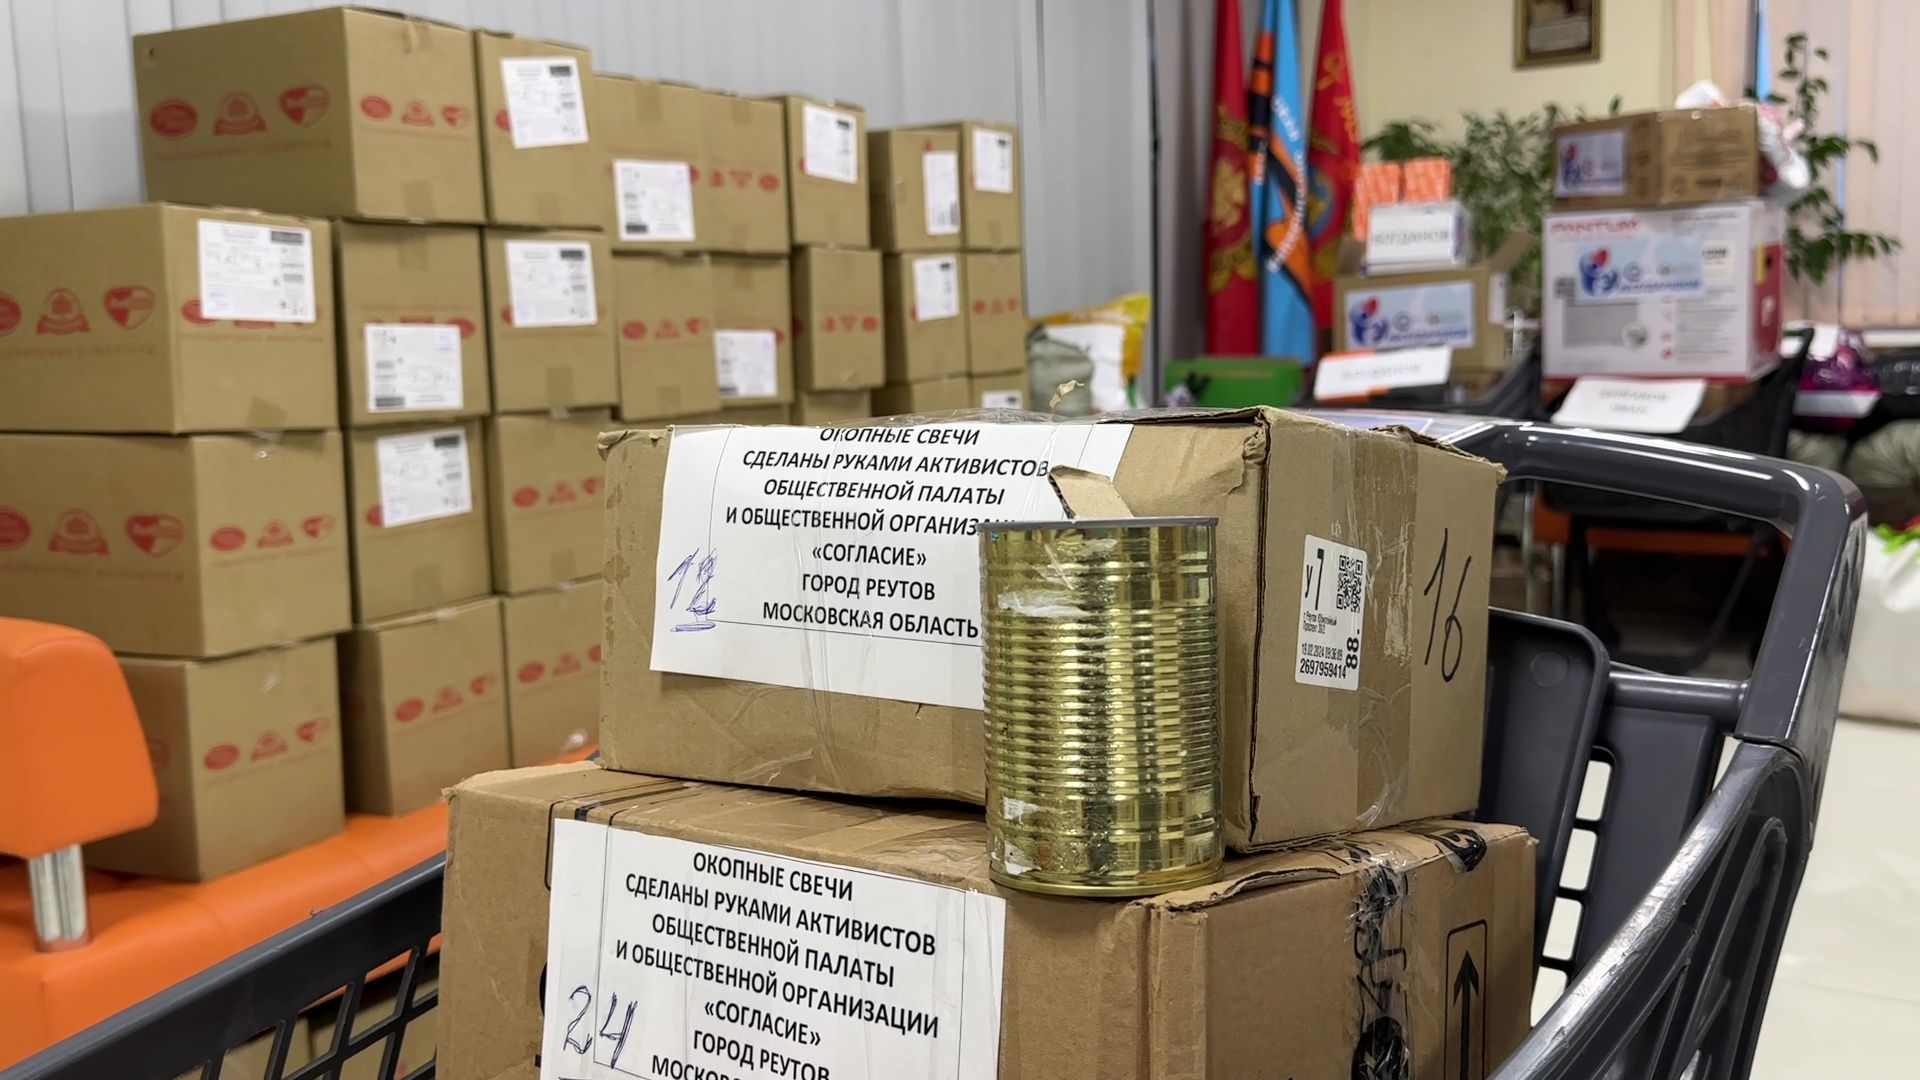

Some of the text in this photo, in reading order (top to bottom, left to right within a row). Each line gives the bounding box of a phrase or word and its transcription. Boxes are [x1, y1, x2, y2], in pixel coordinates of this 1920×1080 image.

[1550, 218, 1641, 235] PANTUM
[819, 428, 981, 446] ОКОПНЫЕ СВЕЧИ
[742, 450, 1049, 477] СДЕЛАНЫ РУКАМИ АКТИВИСТОВ
[763, 478, 1006, 505] ОБЩЕСТВЕННОЙ ПАЛАТЫ
[725, 506, 1016, 536] И ОБЩЕСТВЕННОЙ ОРГАНИЗ
[812, 543, 927, 567] «СОГЛАСИЕ»
[802, 573, 936, 601] ГОРОД РЕУТОВ
[1423, 527, 1472, 683] 16
[763, 602, 979, 639] МОСКОВСКАЯ ОБЛАСТЬ
[1299, 657, 1347, 680] 2697959414
[693, 852, 853, 901] ОКОПНЫЕ СВЕЧИ
[625, 873, 936, 956] СДЕЛАНЫ РУКАМИ АКТИВИСТОВ
[652, 913, 895, 988] ОБЩЕСТВЕННОЙ ПАЛАТЫ
[616, 939, 938, 1038] И ОБЩЕСТВЕННОЙ ОРГАНИЗАЦИИ
[563, 984, 638, 1070] 24
[704, 1000, 821, 1047] «СОГЛАСИЕ»
[694, 1030, 830, 1080] ГОРОД РЕУТОВ
